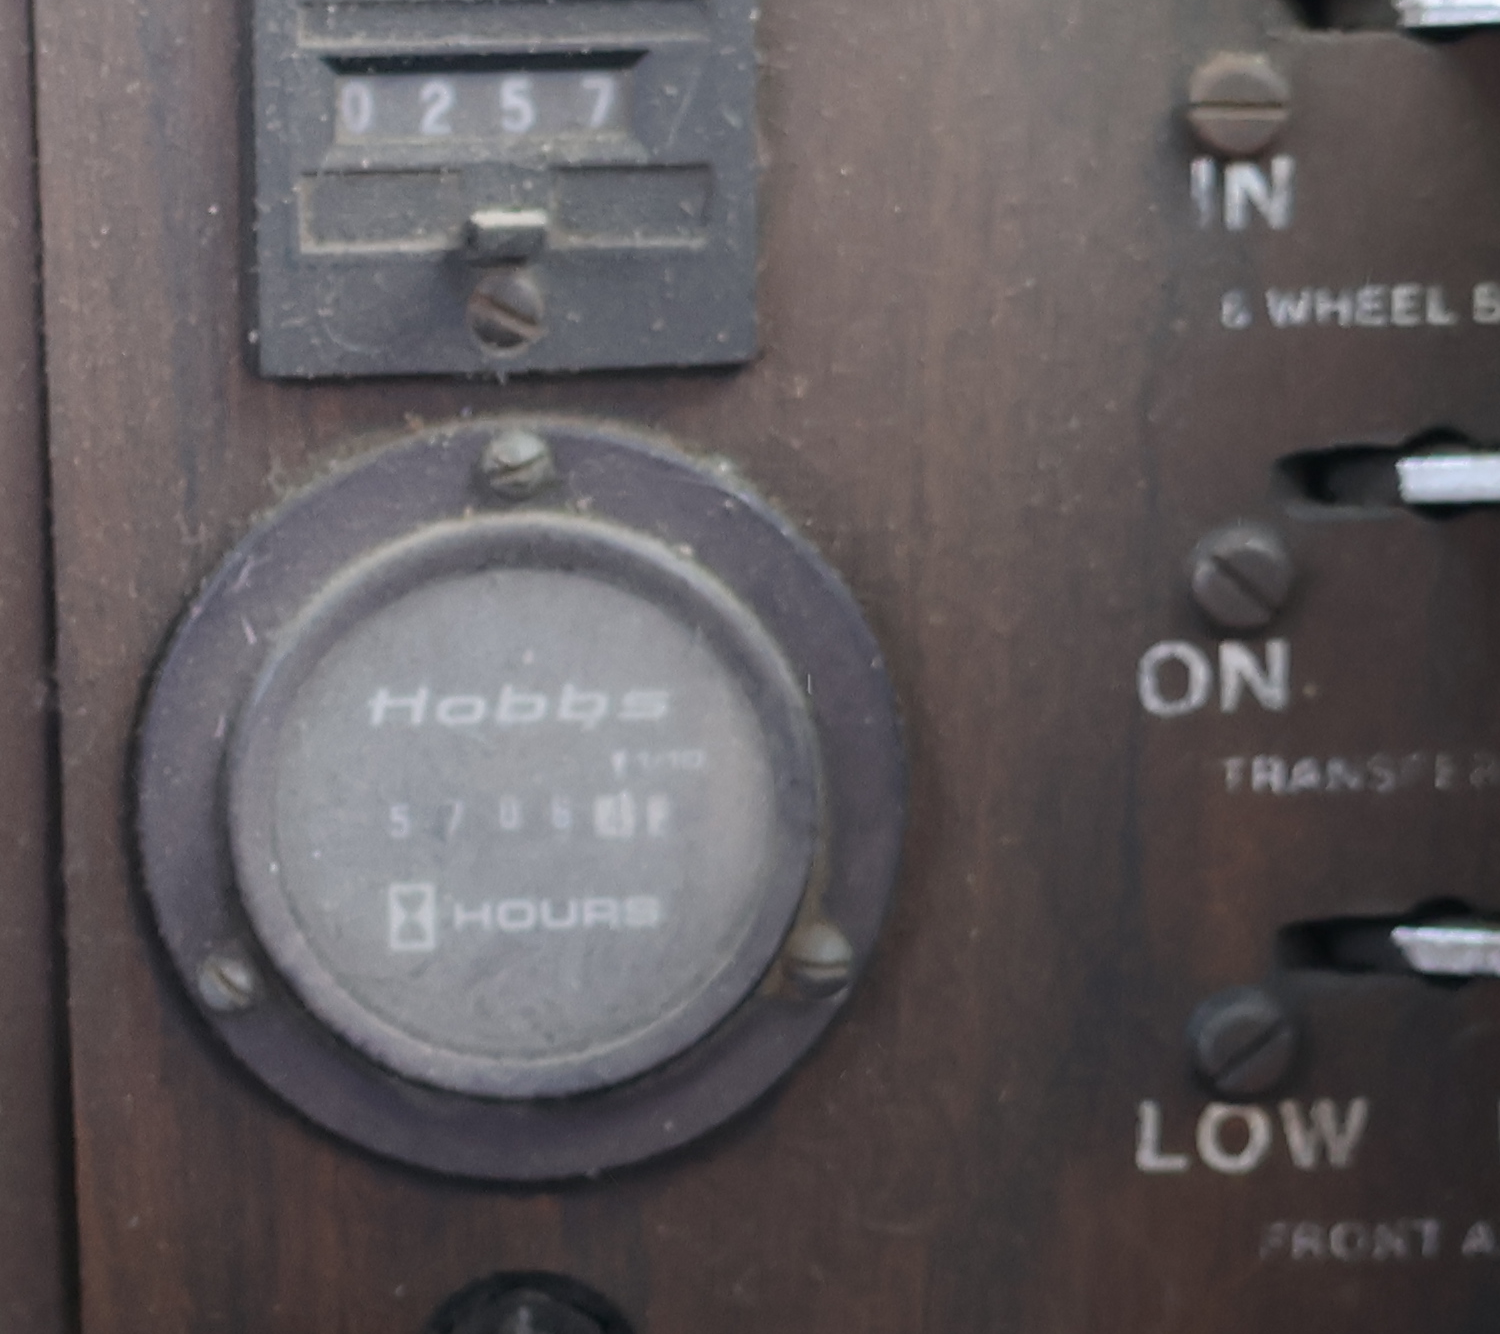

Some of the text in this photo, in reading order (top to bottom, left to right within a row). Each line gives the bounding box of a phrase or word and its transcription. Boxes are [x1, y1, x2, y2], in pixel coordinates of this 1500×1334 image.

[338, 75, 618, 135] 0257
[1189, 157, 1296, 229] IN
[1265, 286, 1458, 327] WHEEL
[1137, 640, 1290, 716] ON
[368, 683, 672, 733] Hobbs
[452, 897, 664, 930] HOURS
[1134, 1097, 1368, 1172] LOW
[1262, 1219, 1440, 1259] FRONT
